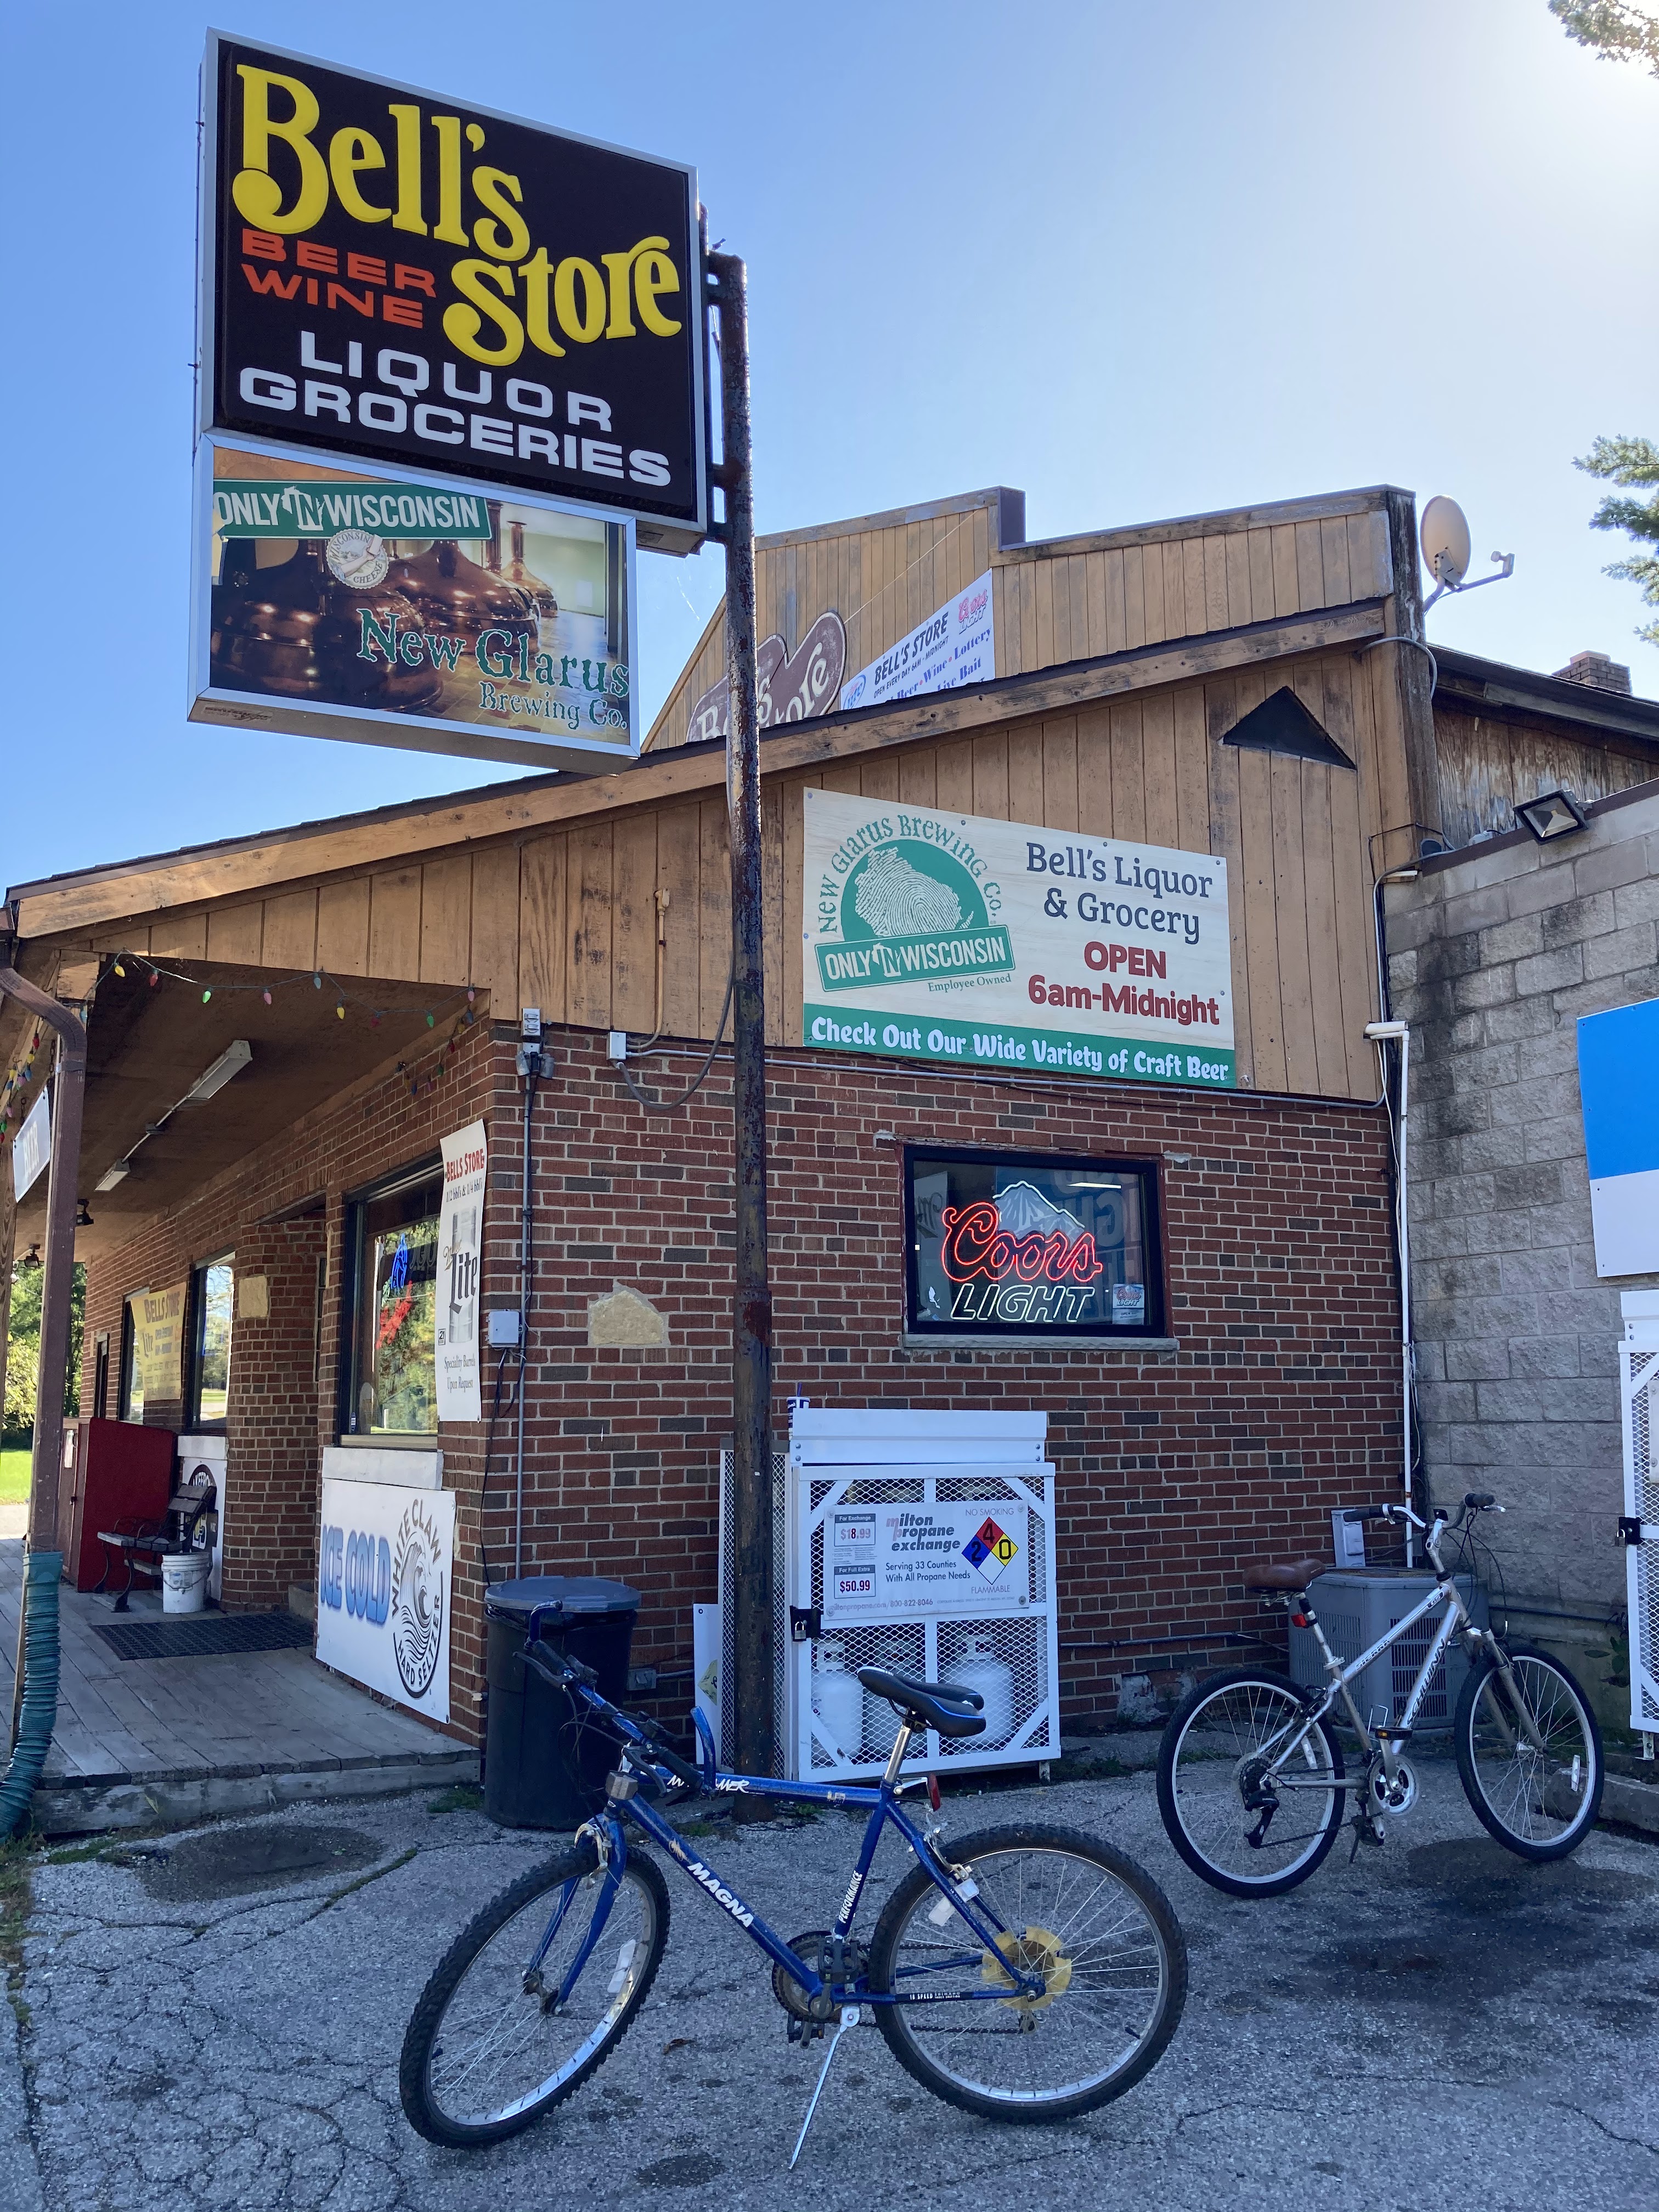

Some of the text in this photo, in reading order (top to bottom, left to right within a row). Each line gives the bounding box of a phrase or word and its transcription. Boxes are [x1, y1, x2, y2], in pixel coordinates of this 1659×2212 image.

[232, 64, 531, 261] Bell's
[242, 228, 437, 297] BEER
[240, 263, 424, 329] WINE
[443, 236, 682, 366] Store
[301, 330, 613, 432] LIQUOR
[239, 367, 672, 487] GROCERIES
[213, 492, 282, 526] ONLY
[323, 494, 481, 528] WISCONSIN
[329, 532, 371, 563] WISCONSIN
[353, 560, 383, 584] CHEESE
[958, 589, 988, 623] Coors
[958, 604, 987, 635] LIGHT
[356, 607, 629, 698] New Glarus
[873, 685, 885, 699] OPEN
[886, 675, 900, 690] EVERY
[901, 665, 911, 679] DAY
[911, 659, 922, 672] 6AM
[925, 635, 949, 661] MIDNIGHT
[874, 611, 949, 686] BELL'S STORE
[923, 661, 948, 684] Wine
[954, 627, 992, 661] Lottery
[960, 656, 982, 681] Bait
[479, 681, 628, 730] Brewing Co.
[817, 874, 840, 934] New
[831, 817, 893, 874] Glarus
[897, 815, 988, 878] Brewing
[1026, 842, 1213, 899] Bell's Liquor
[1043, 887, 1200, 945] & Grocery
[825, 950, 872, 980] ONLY
[900, 936, 1007, 972] WISCONSIN
[1084, 941, 1166, 979] OPEN
[927, 973, 1012, 993] Employee Owned
[1028, 974, 1220, 1026] 6am-Midnight
[811, 1016, 1229, 1081] Check Out Our Wide Variety of Craft Beer
[446, 1148, 484, 1183] BELLS STORE
[462, 1184, 466, 1197] &
[941, 1201, 1103, 1283] Coors
[449, 1251, 477, 1314] Lite
[950, 1283, 1096, 1323] LIGHT
[144, 1296, 165, 1323] BELLS
[458, 1376, 473, 1392] Request
[840, 1527, 871, 1541] $18.99
[886, 1513, 933, 1527] milton
[893, 1526, 955, 1542] propane
[979, 1508, 1014, 1516] SMOKING
[983, 1522, 995, 1544] 4
[392, 1498, 442, 1618] WHITE CLAW
[885, 1562, 913, 1572] Serving
[927, 1560, 957, 1568] Counties
[891, 1538, 961, 1553] exchange
[971, 1539, 1012, 1562] 2 0
[319, 1523, 391, 1627] ICE COLD
[839, 1579, 871, 1594] $50.99
[885, 1570, 970, 1583] With All Propane Needs
[971, 1584, 1011, 1594] FLAMMABLE
[398, 1594, 441, 1688] HARD SELTZER
[1407, 1637, 1446, 1726] SCHWINN
[687, 1862, 755, 1928] MAGNA
[838, 1869, 863, 1924] PERFORMANCE
